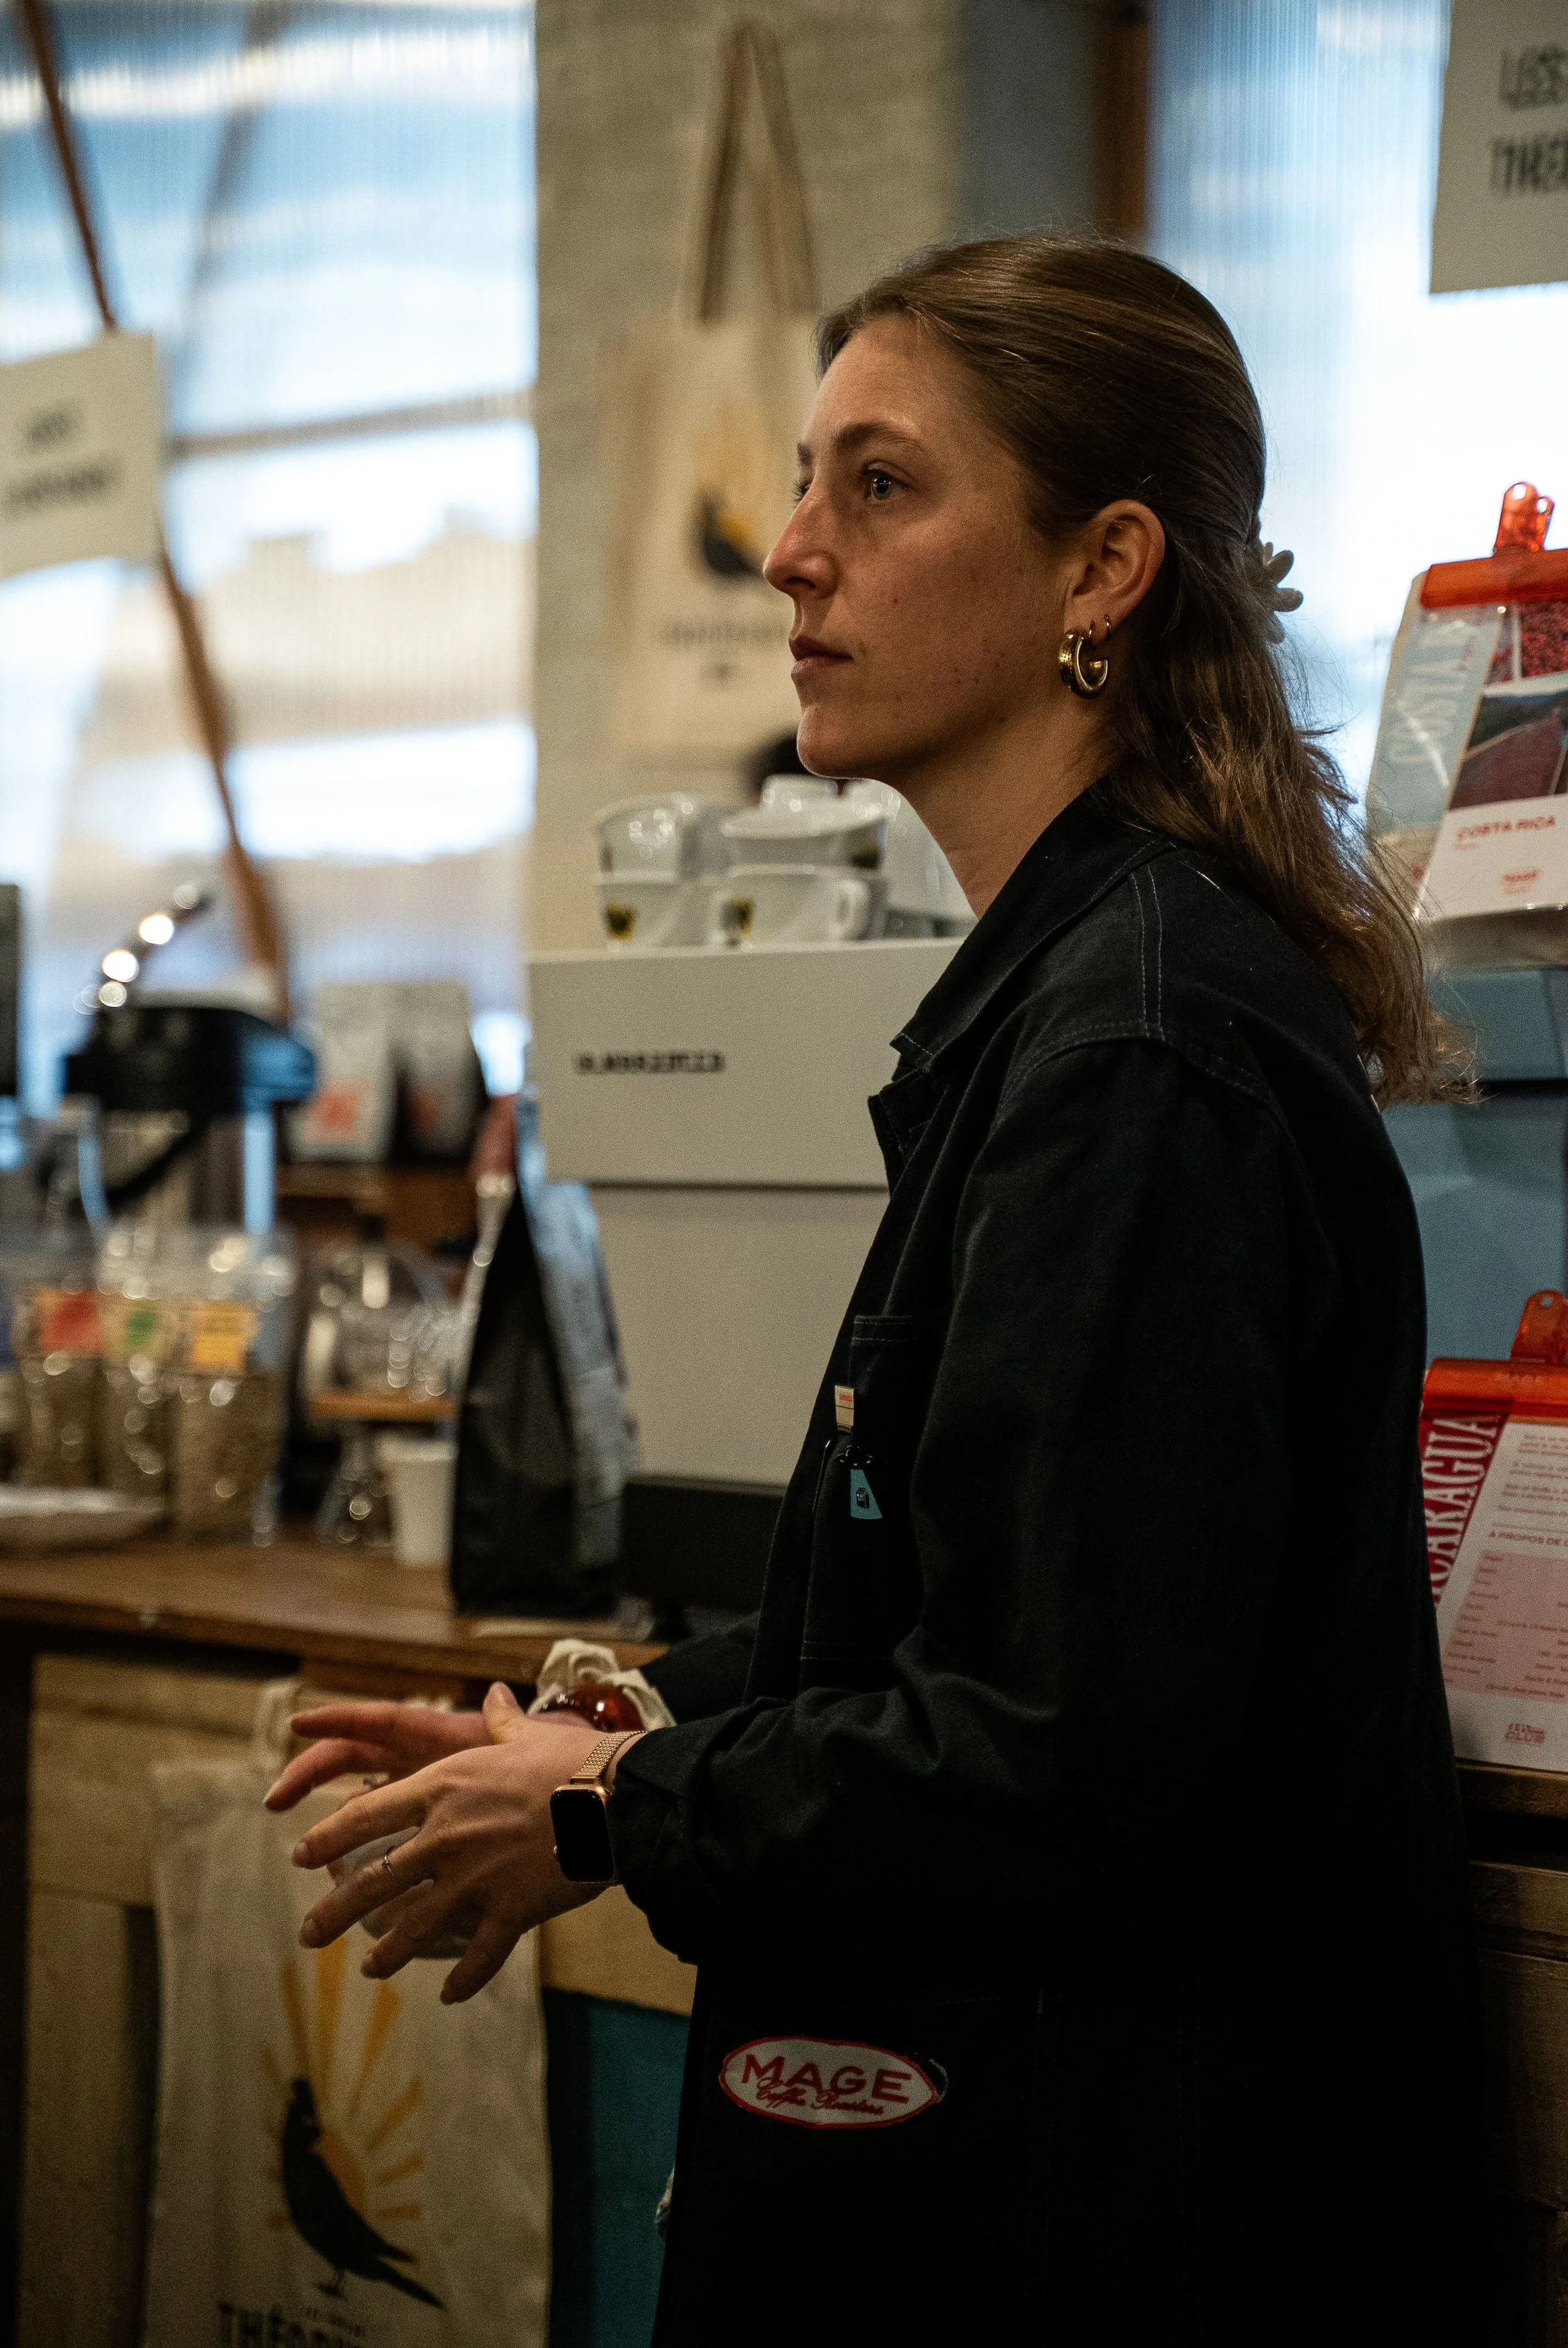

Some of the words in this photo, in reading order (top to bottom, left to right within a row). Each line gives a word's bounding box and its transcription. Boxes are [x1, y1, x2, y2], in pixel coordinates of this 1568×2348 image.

[1457, 821, 1512, 840] COSTA
[1516, 816, 1555, 831] RICA
[1421, 1417, 1498, 1595] CARAGUA
[742, 2054, 911, 2103] MAGE
